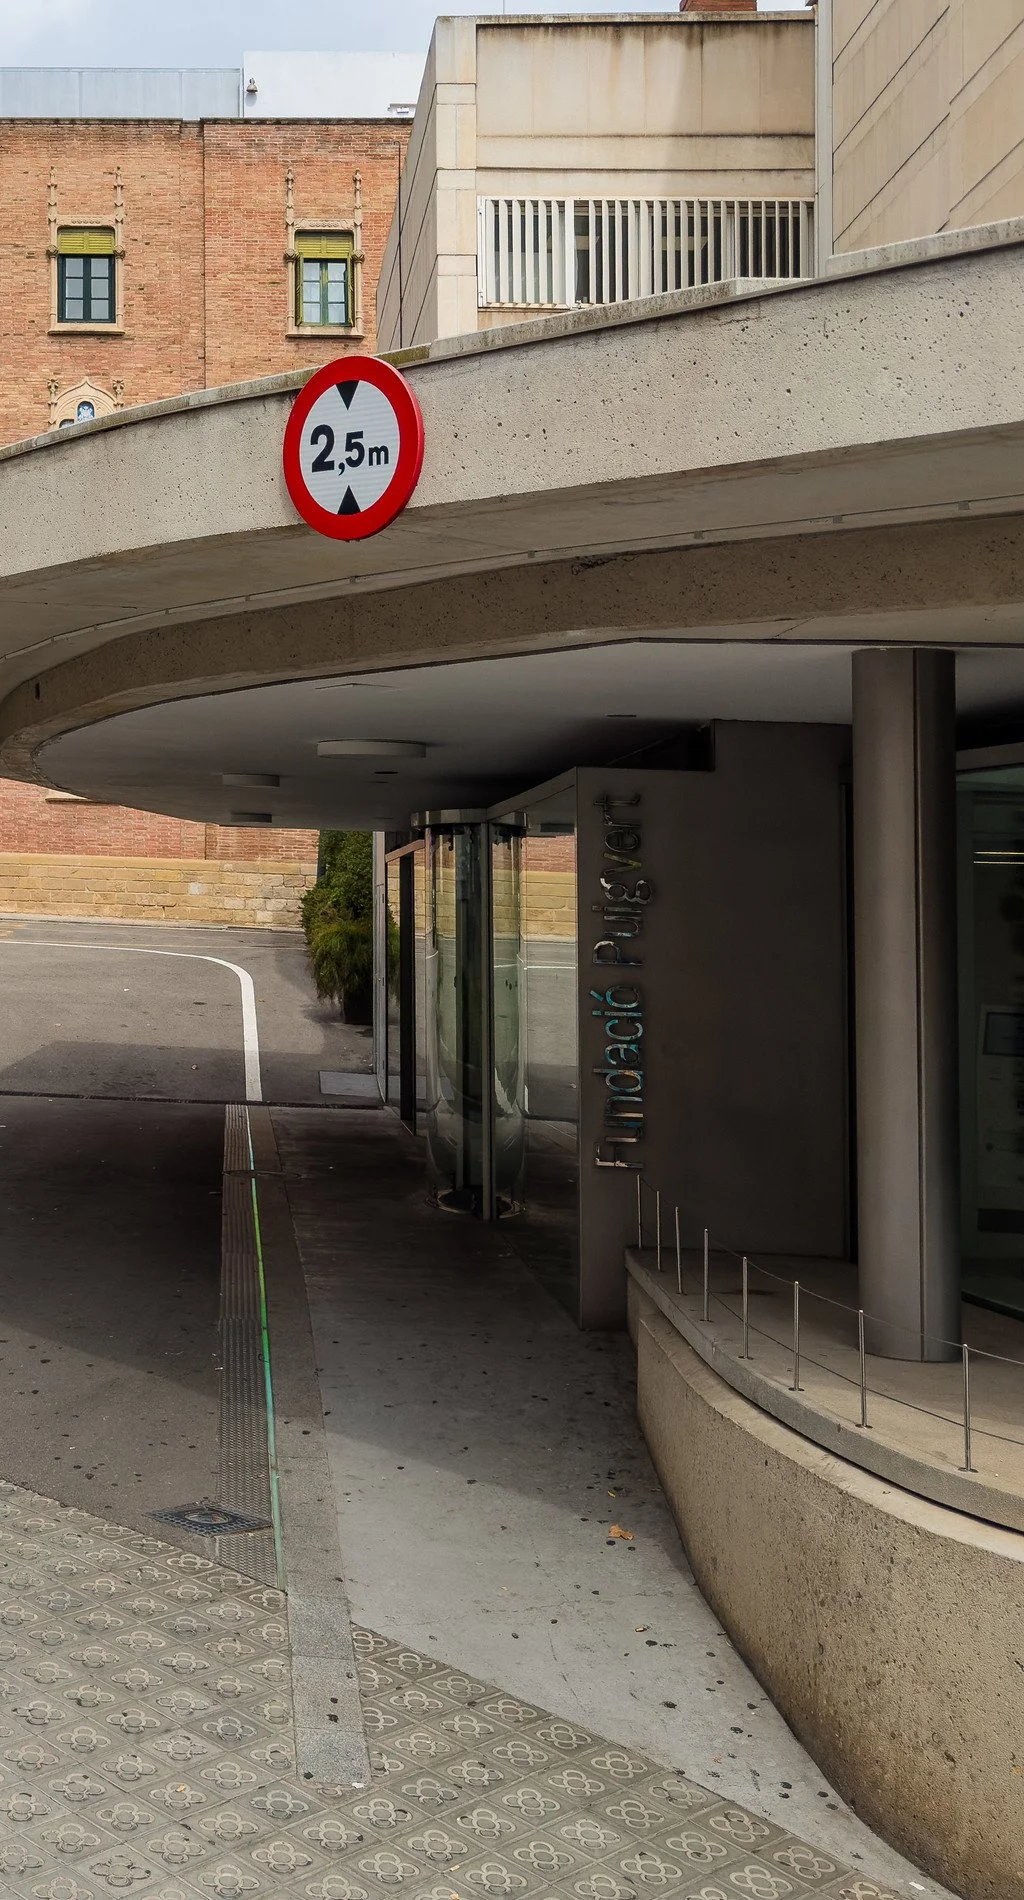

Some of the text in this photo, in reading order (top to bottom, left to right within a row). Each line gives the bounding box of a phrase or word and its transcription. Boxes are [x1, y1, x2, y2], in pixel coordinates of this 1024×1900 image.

[310, 424, 390, 476] 2,5m
[589, 793, 654, 1169] Fundació Puigvert
